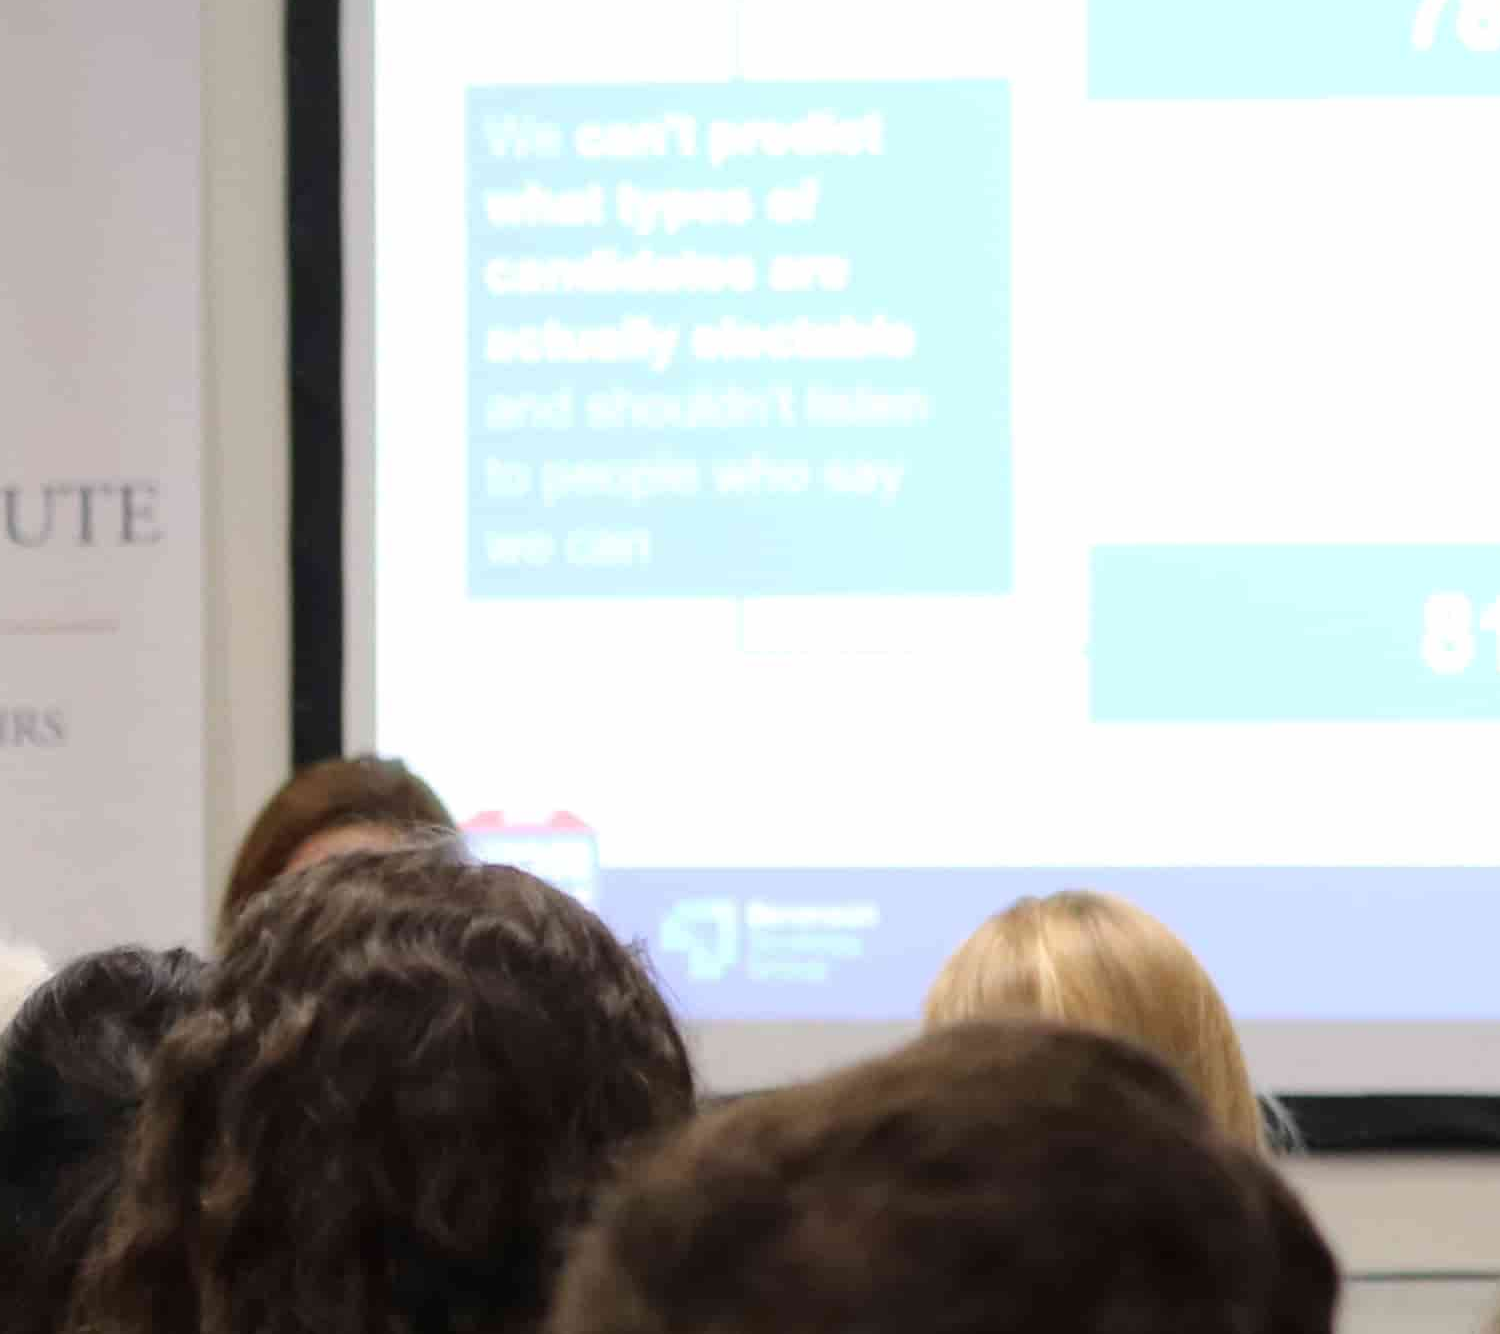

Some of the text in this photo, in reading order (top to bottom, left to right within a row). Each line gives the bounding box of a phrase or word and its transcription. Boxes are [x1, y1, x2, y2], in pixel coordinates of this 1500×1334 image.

[573, 112, 697, 158] can't
[706, 108, 886, 169] predict
[483, 174, 823, 236] what types of
[483, 248, 852, 293] candidates are
[484, 315, 919, 374] actually electable
[484, 386, 936, 429] and shouldn't listen
[484, 452, 906, 507] to people who say
[484, 529, 652, 567] we can
